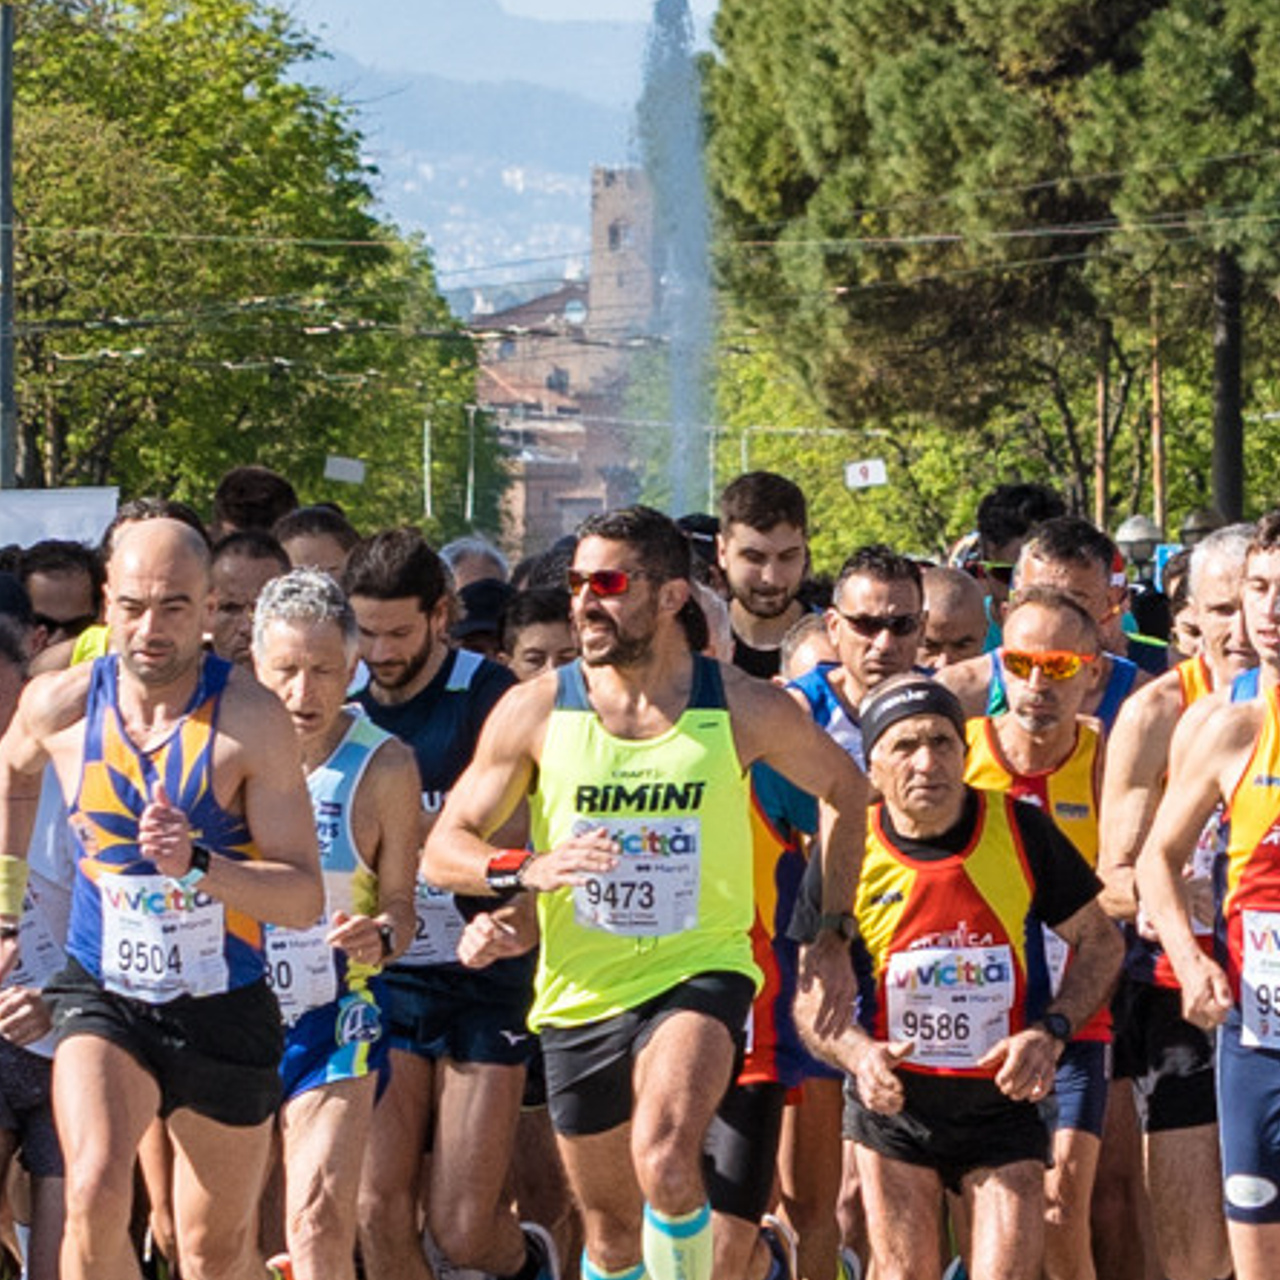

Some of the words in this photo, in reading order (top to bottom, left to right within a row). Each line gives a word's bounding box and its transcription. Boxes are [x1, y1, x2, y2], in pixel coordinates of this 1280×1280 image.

[575, 780, 706, 813] RIMINI
[586, 877, 655, 910] 9473
[118, 938, 182, 974] 9504
[894, 955, 1005, 989] vivicittà
[902, 1010, 971, 1041] 9586
